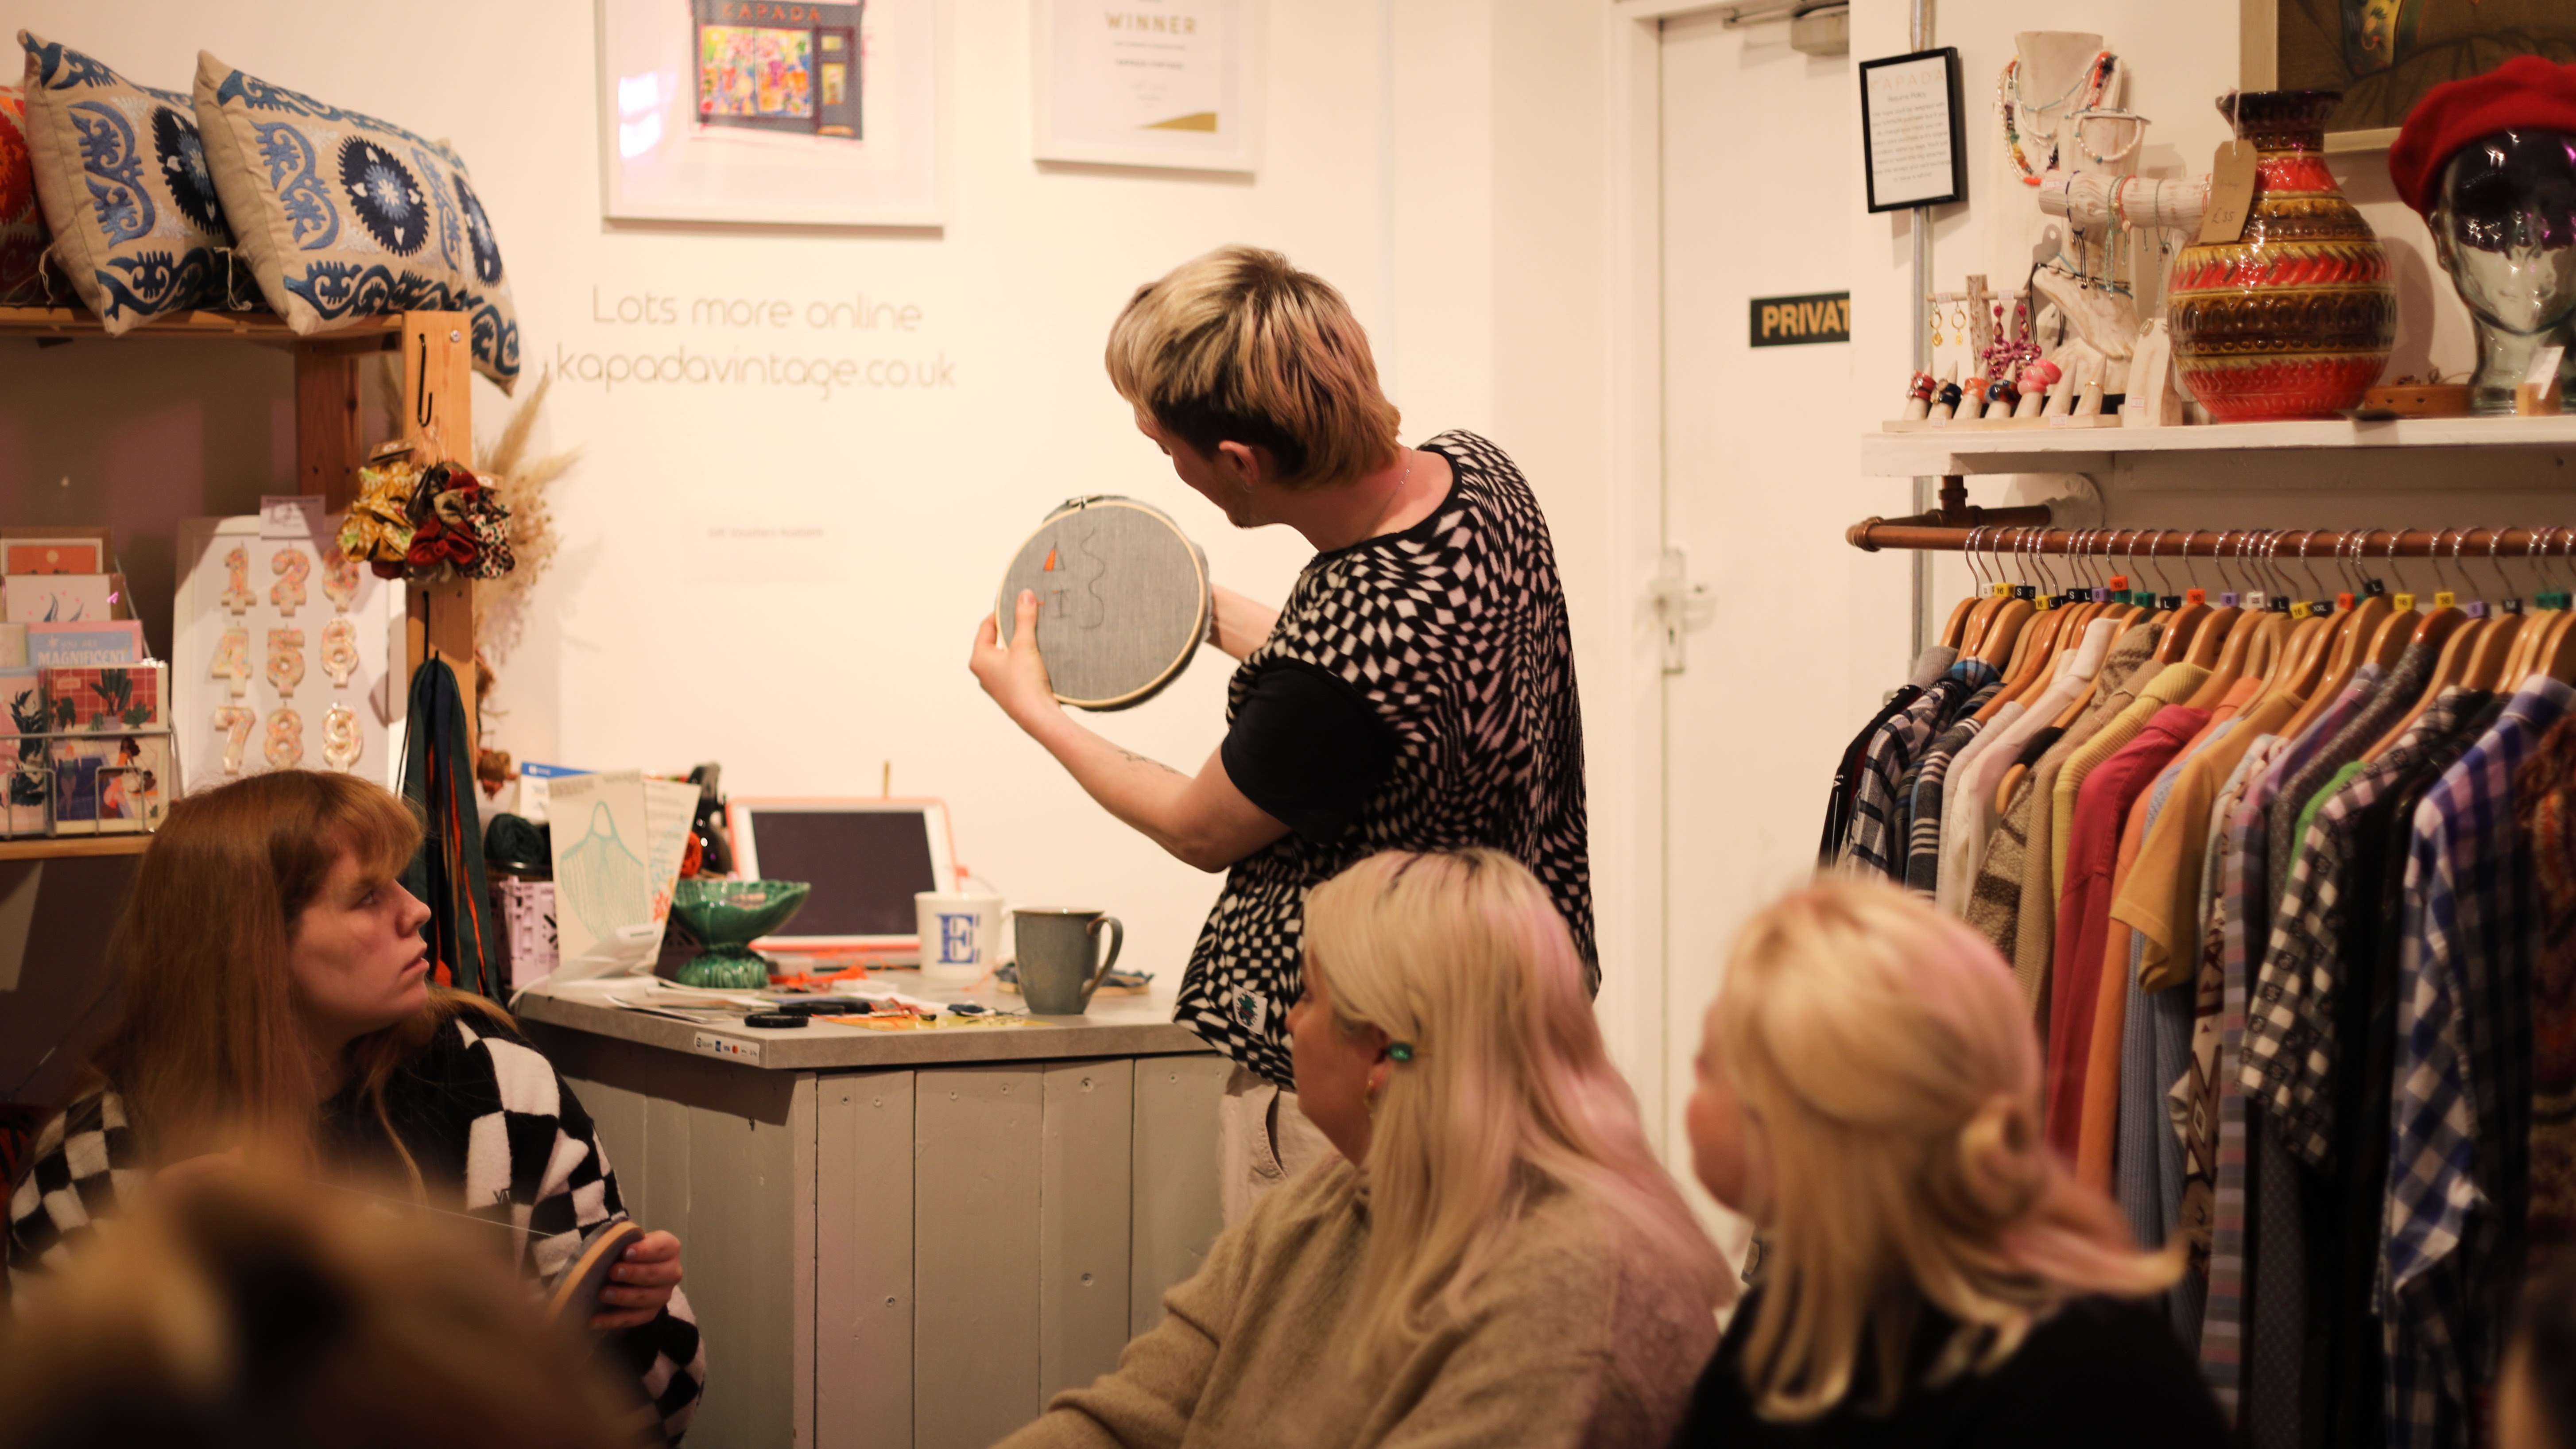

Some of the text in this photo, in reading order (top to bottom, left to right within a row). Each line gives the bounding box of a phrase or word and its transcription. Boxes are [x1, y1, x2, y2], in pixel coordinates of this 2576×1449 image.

[722, 3, 821, 22] KAPADA
[1104, 12, 1197, 35] WINNER
[1869, 69, 1945, 92] KAPADA
[594, 285, 922, 331] Lots more online
[557, 341, 957, 402] kapadavintage.co.uk
[270, 548, 309, 606] 2
[38, 650, 124, 665] MAGNIFICENT
[212, 619, 358, 693] 4 5 6
[215, 706, 362, 773] 7 8 9
[935, 913, 980, 964] E
